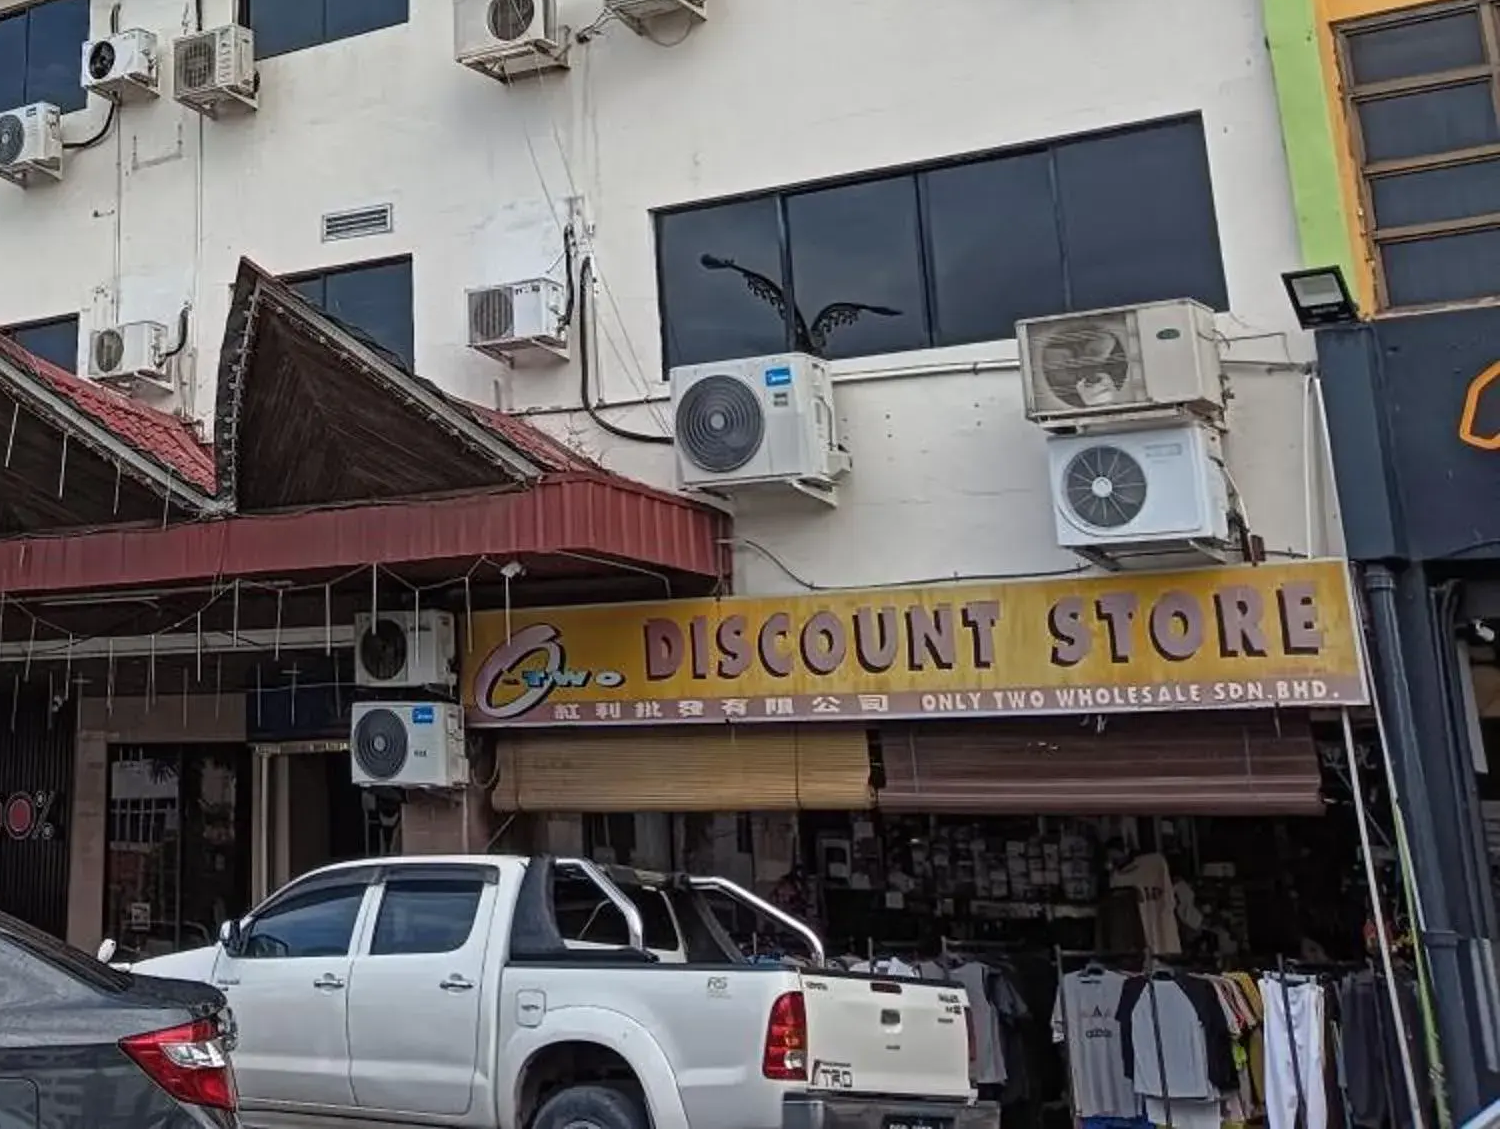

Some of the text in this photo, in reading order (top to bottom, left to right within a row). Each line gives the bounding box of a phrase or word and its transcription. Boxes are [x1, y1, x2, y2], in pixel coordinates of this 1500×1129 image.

[643, 578, 1325, 681] DISCOUNT STORE
[921, 691, 983, 712] ONLY
[993, 689, 1045, 709] TWO
[1055, 685, 1202, 707] WHOLESALE
